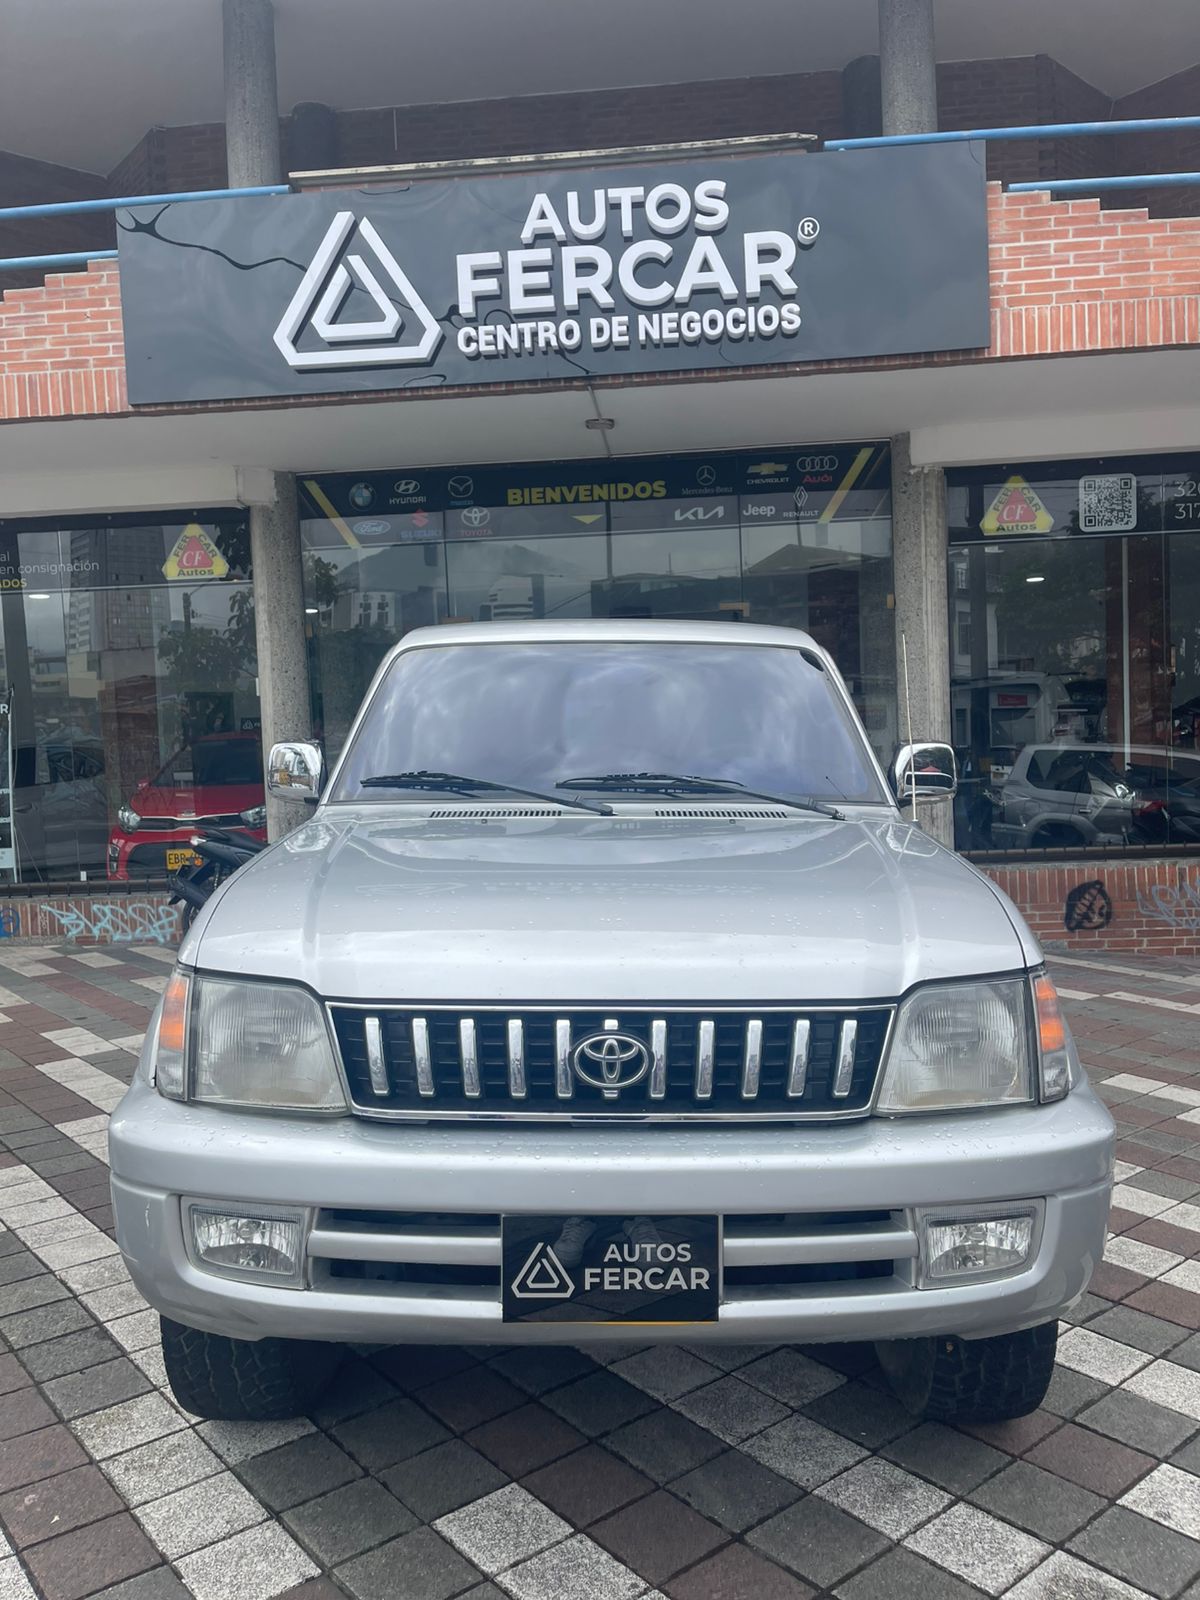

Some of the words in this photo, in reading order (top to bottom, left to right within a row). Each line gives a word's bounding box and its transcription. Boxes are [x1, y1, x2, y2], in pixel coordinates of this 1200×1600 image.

[521, 180, 729, 243] AUTOS
[456, 230, 798, 318] FERCAR
[457, 318, 582, 358] CENTRO
[590, 314, 630, 349] DE
[639, 303, 802, 346] NEGOCIOS
[507, 480, 667, 506] BIENVENIDOS
[1174, 480, 1200, 497] 32
[389, 496, 427, 505] HYUNDAI
[1021, 486, 1041, 513] CAR
[674, 506, 725, 521] KIA
[743, 504, 776, 518] Jeep
[783, 510, 819, 518] RENAULT
[1003, 504, 1027, 521] CF
[401, 529, 442, 538] SUZUKI
[460, 528, 493, 537] TOYOTA
[996, 523, 1037, 532] Autos
[173, 534, 190, 558] FER
[198, 534, 218, 559] CAR
[18, 559, 100, 575] consignación
[183, 550, 205, 567] CF
[177, 568, 214, 577] Autos
[604, 1243, 692, 1263] AUTOS
[584, 1267, 711, 1291] FERCAR
